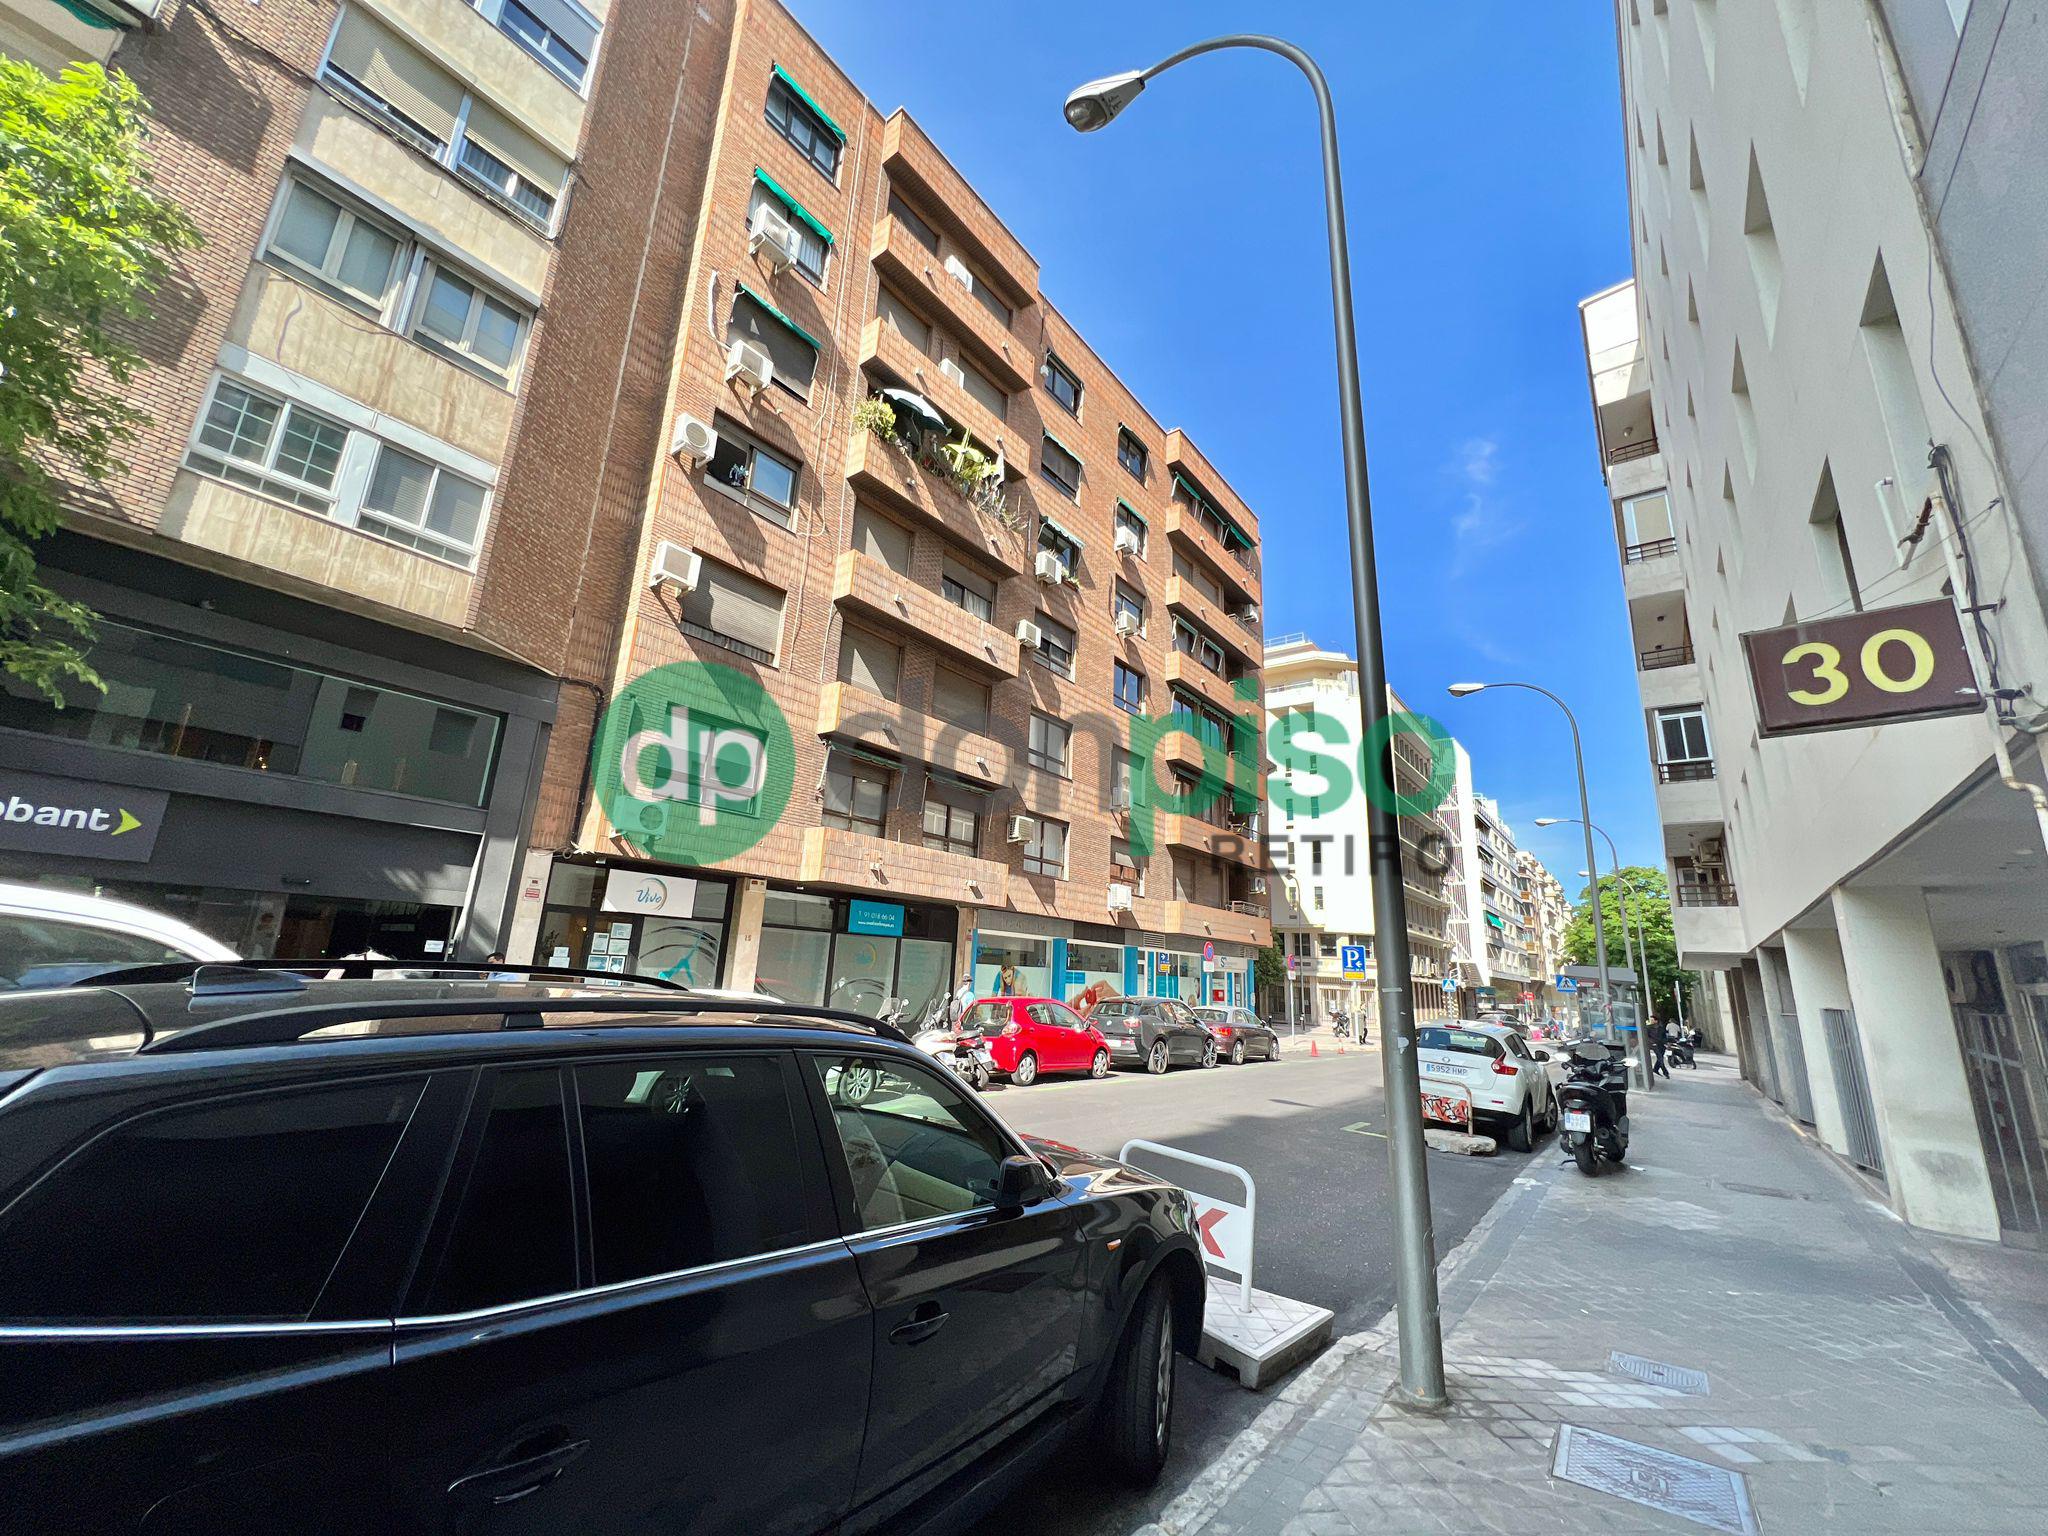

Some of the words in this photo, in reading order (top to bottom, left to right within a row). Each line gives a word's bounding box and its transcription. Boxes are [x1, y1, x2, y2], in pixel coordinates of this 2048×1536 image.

[1782, 628, 1935, 706] 30
[0, 796, 111, 832] bant
[1344, 949, 1359, 968] P
